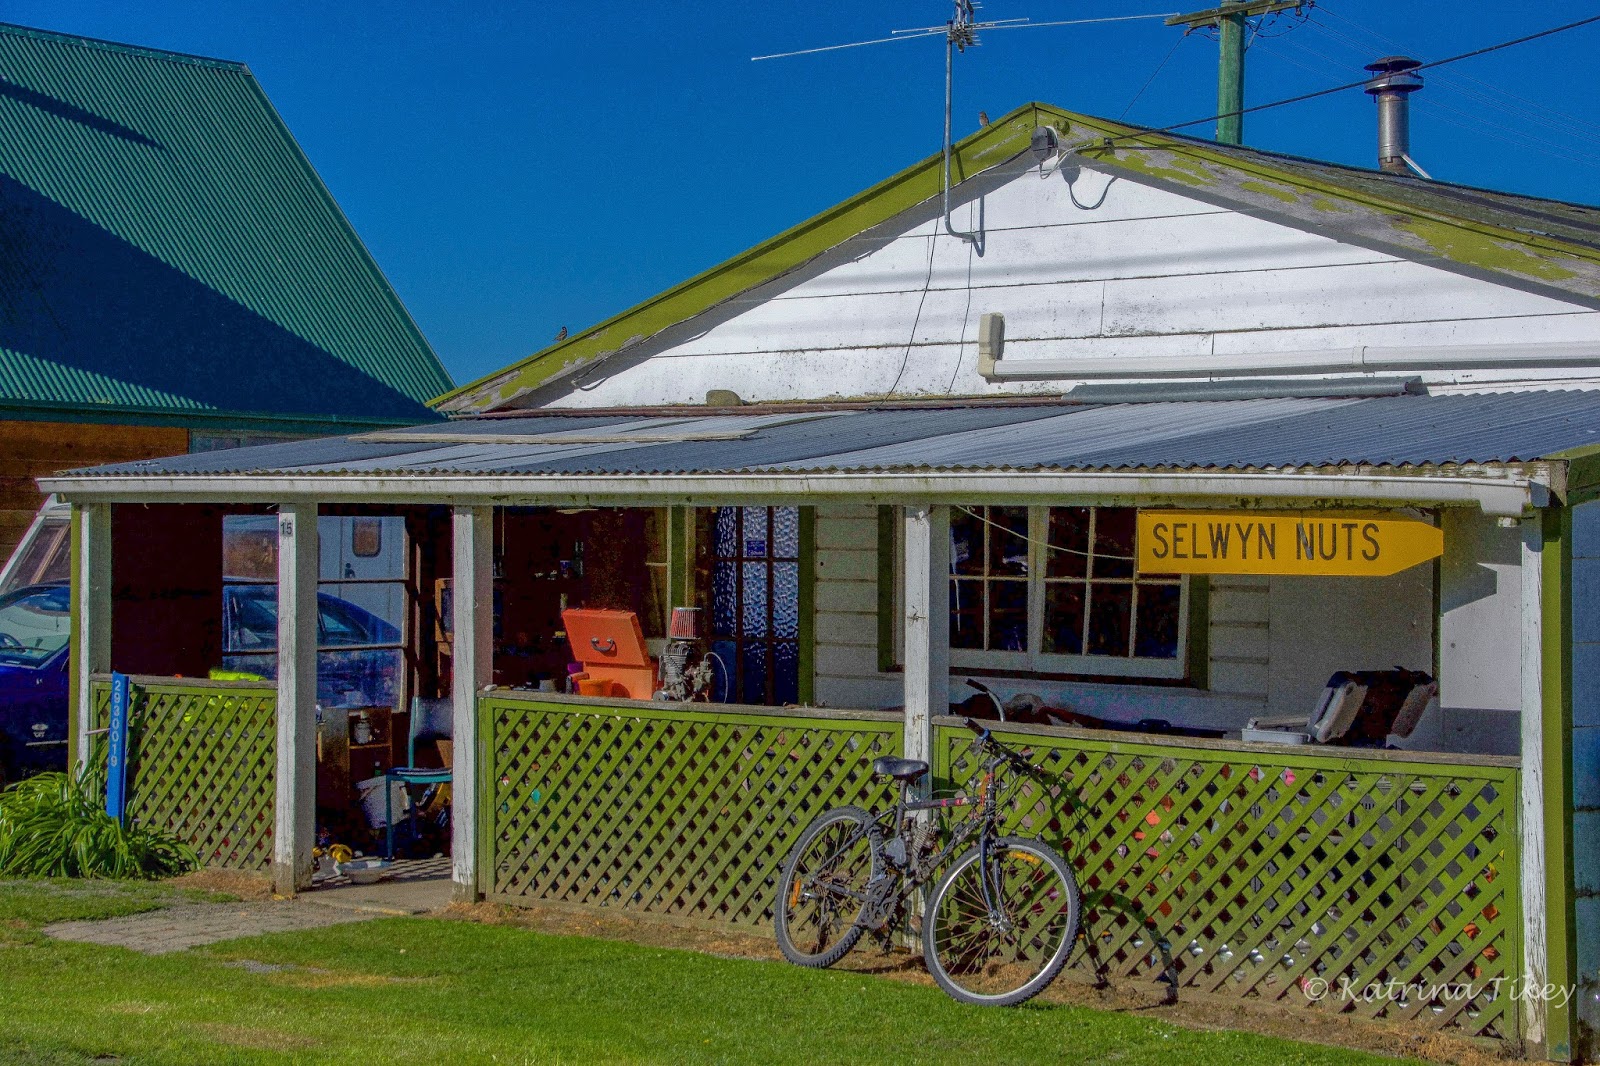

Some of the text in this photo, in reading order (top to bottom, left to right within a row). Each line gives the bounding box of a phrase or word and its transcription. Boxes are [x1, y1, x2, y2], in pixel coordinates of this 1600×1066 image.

[280, 521, 293, 535] 15
[1152, 522, 1381, 561] SELWYN NUTS
